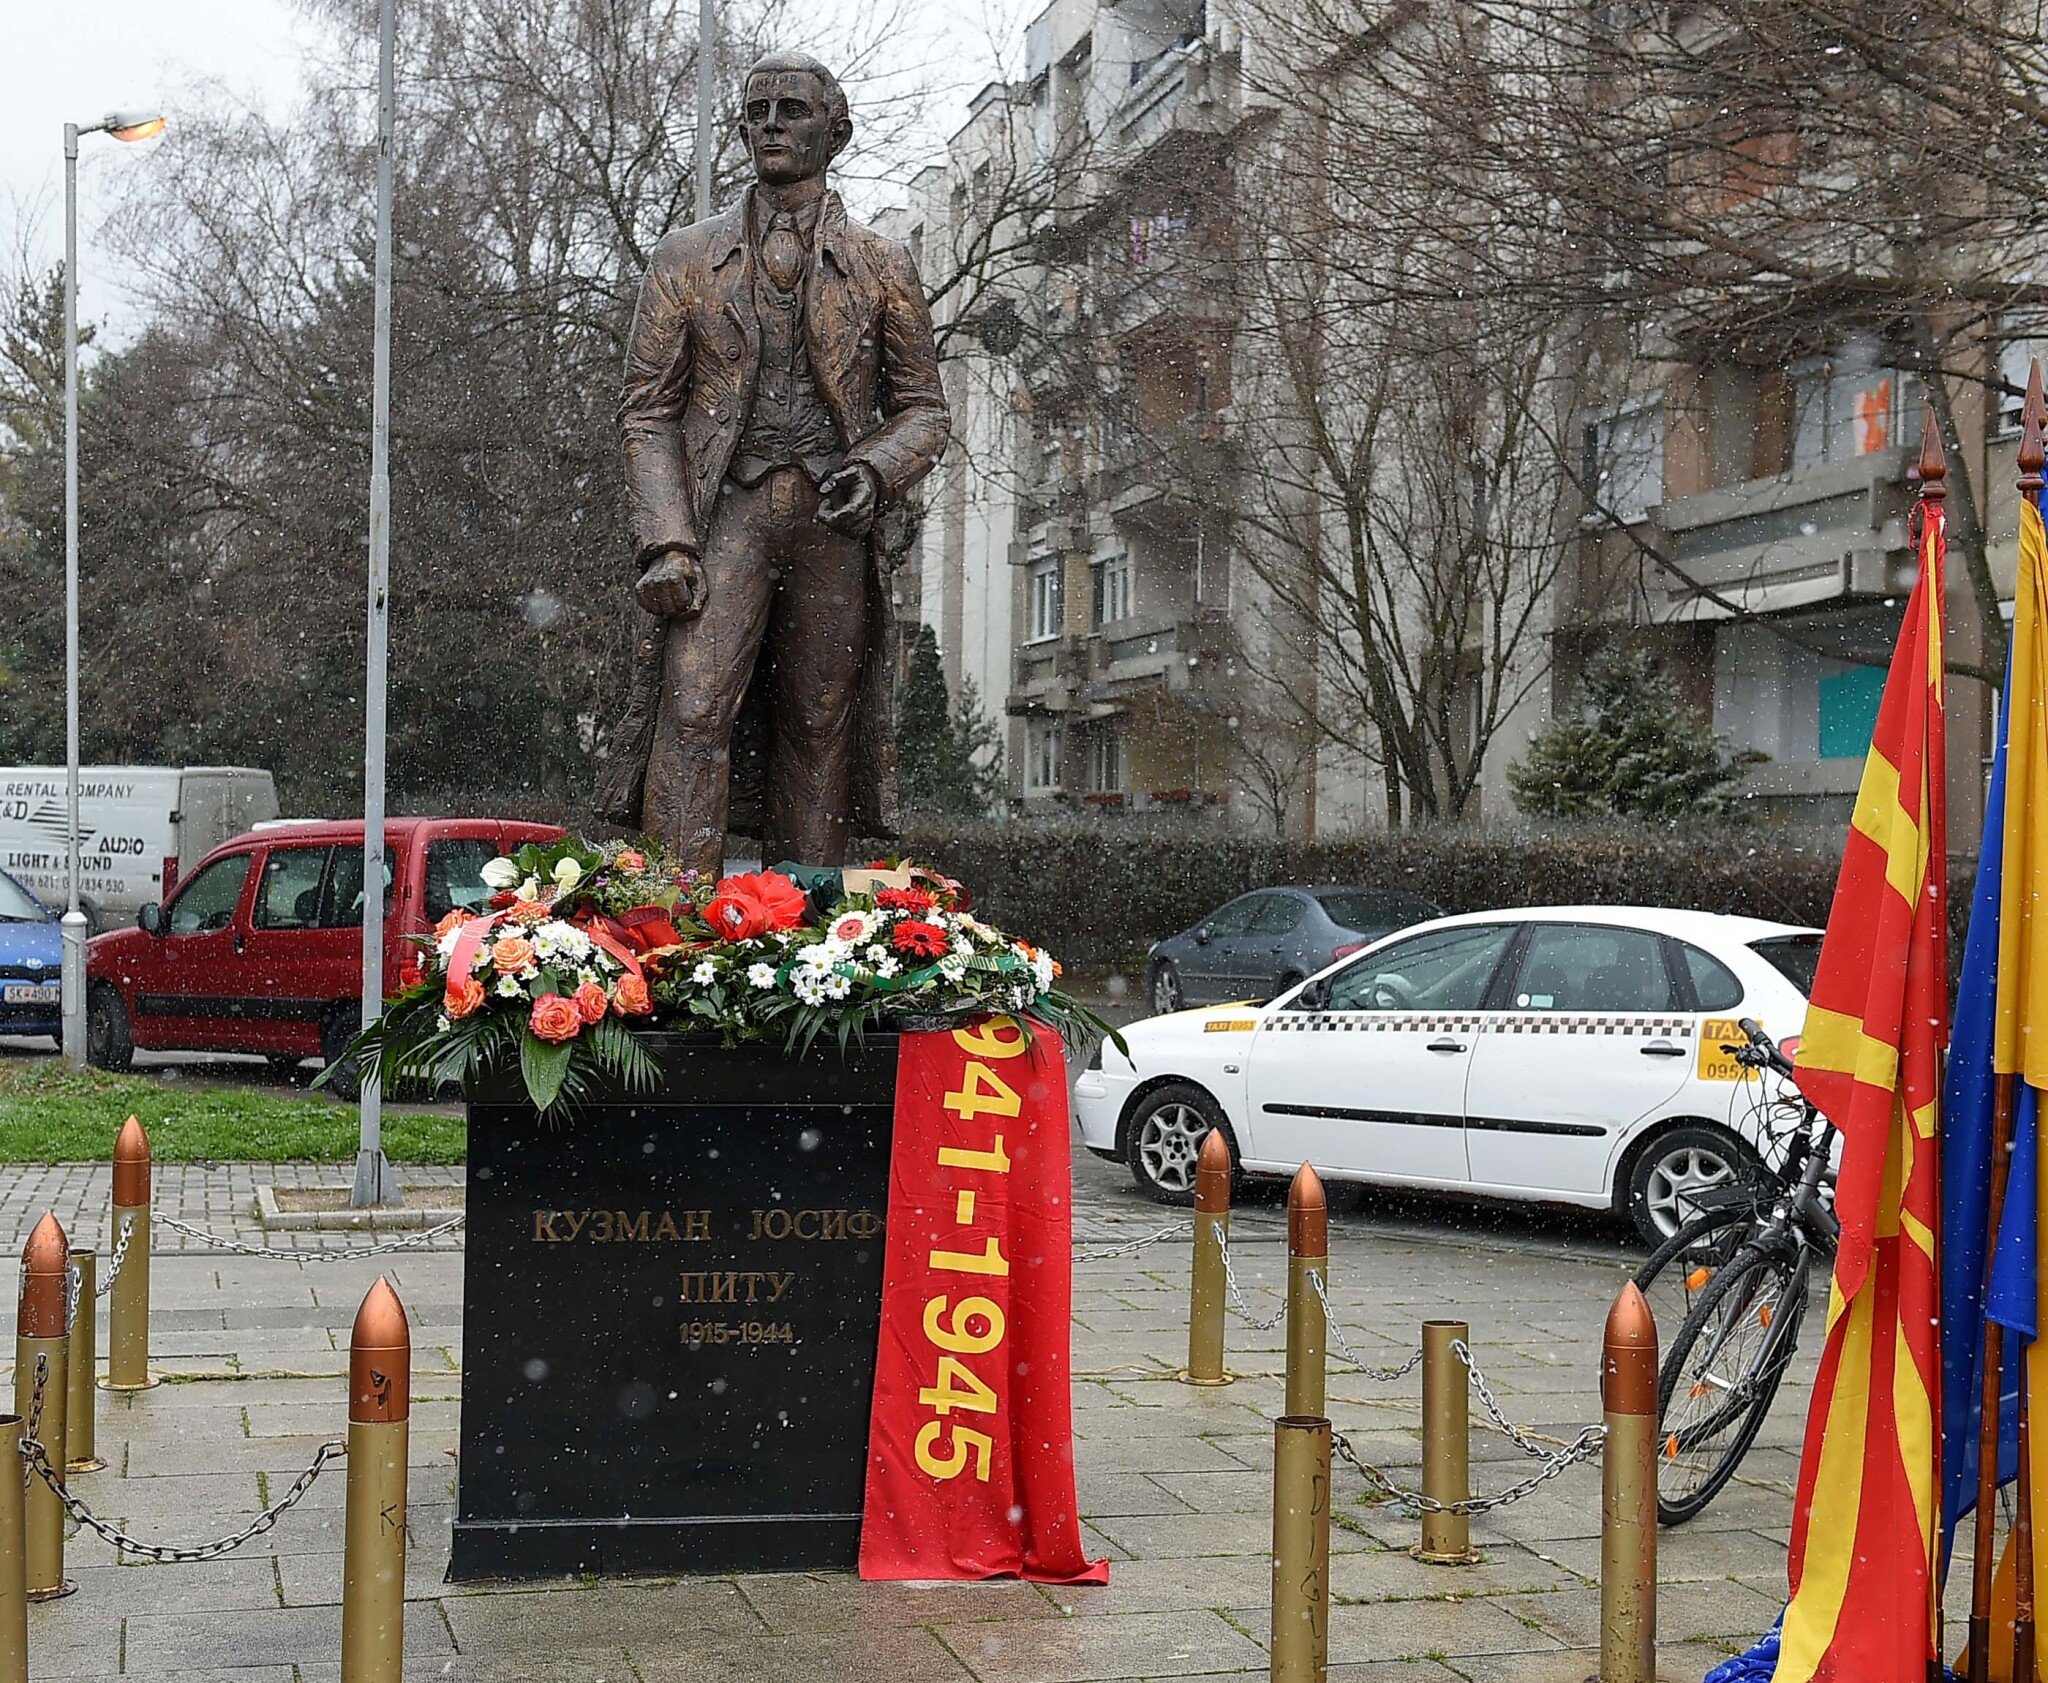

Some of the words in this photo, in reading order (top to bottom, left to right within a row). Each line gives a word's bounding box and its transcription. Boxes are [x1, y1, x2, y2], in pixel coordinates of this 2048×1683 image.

[6, 783, 58, 797] RENTAL
[65, 784, 134, 799] OMPANY
[8, 853, 50, 868] LIGHT
[1206, 1021, 1229, 1031] TAXI
[531, 1208, 711, 1242] КУЗМАН
[679, 1270, 796, 1304] ПИТУ
[679, 1321, 794, 1344] 1915-1944
